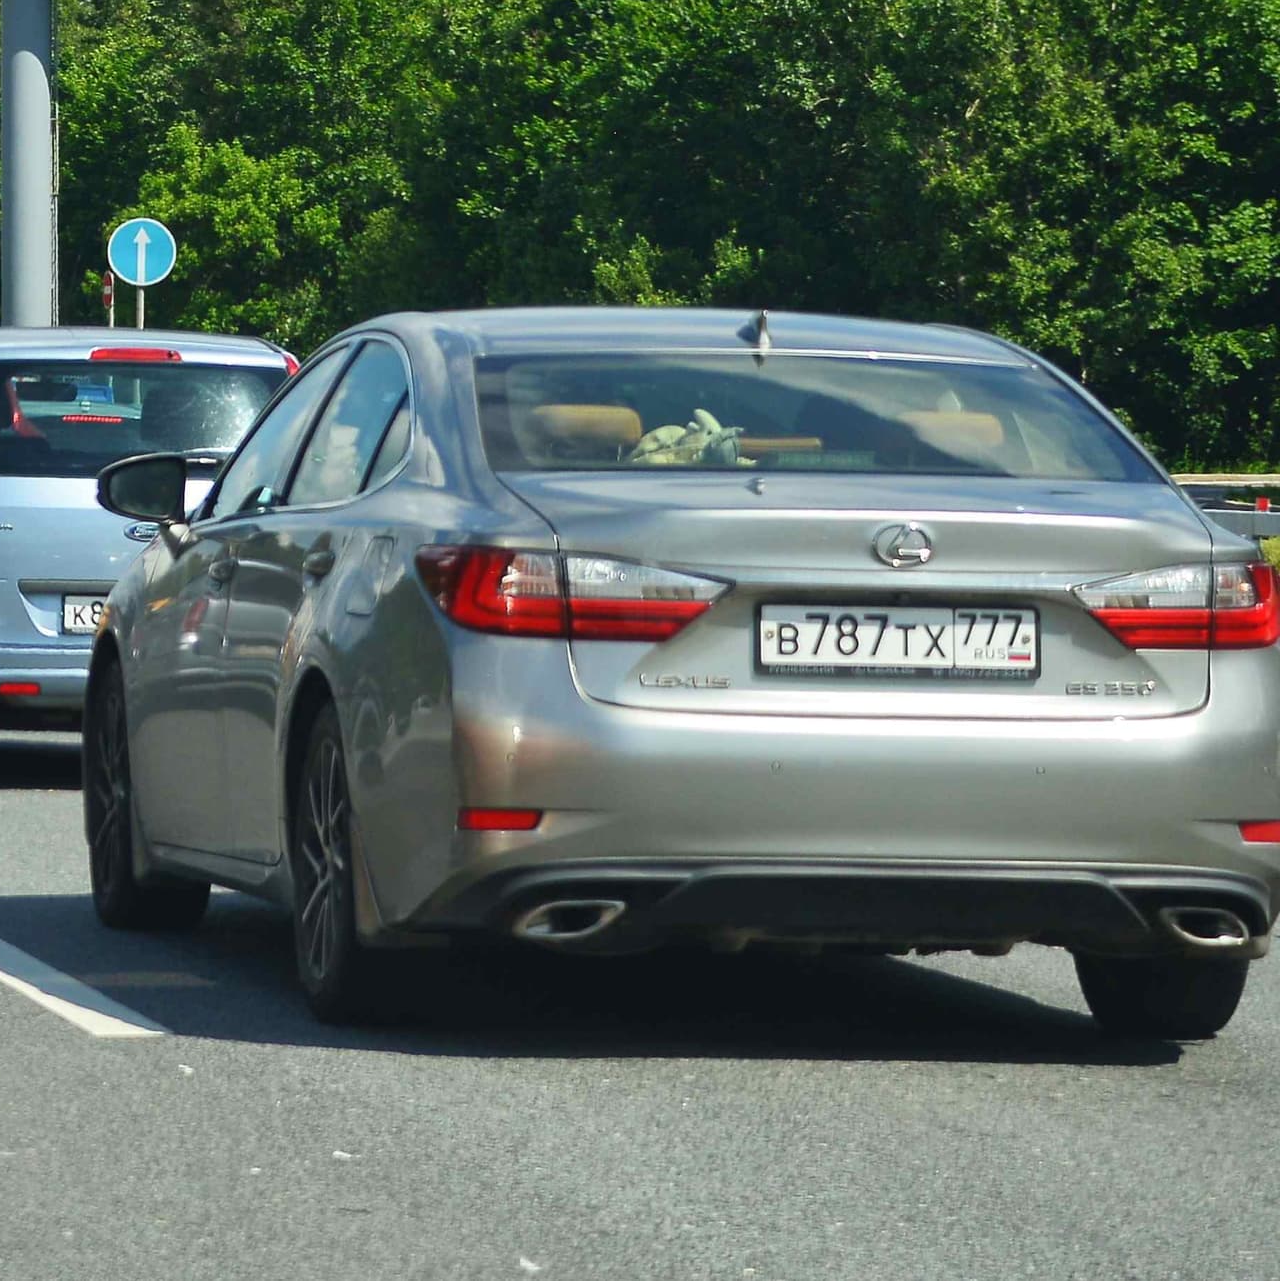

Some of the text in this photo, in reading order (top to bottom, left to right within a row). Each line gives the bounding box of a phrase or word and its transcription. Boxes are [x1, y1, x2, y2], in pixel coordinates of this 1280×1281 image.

[777, 612, 1024, 658] В787ТХ 777
[973, 646, 1007, 661] RUS
